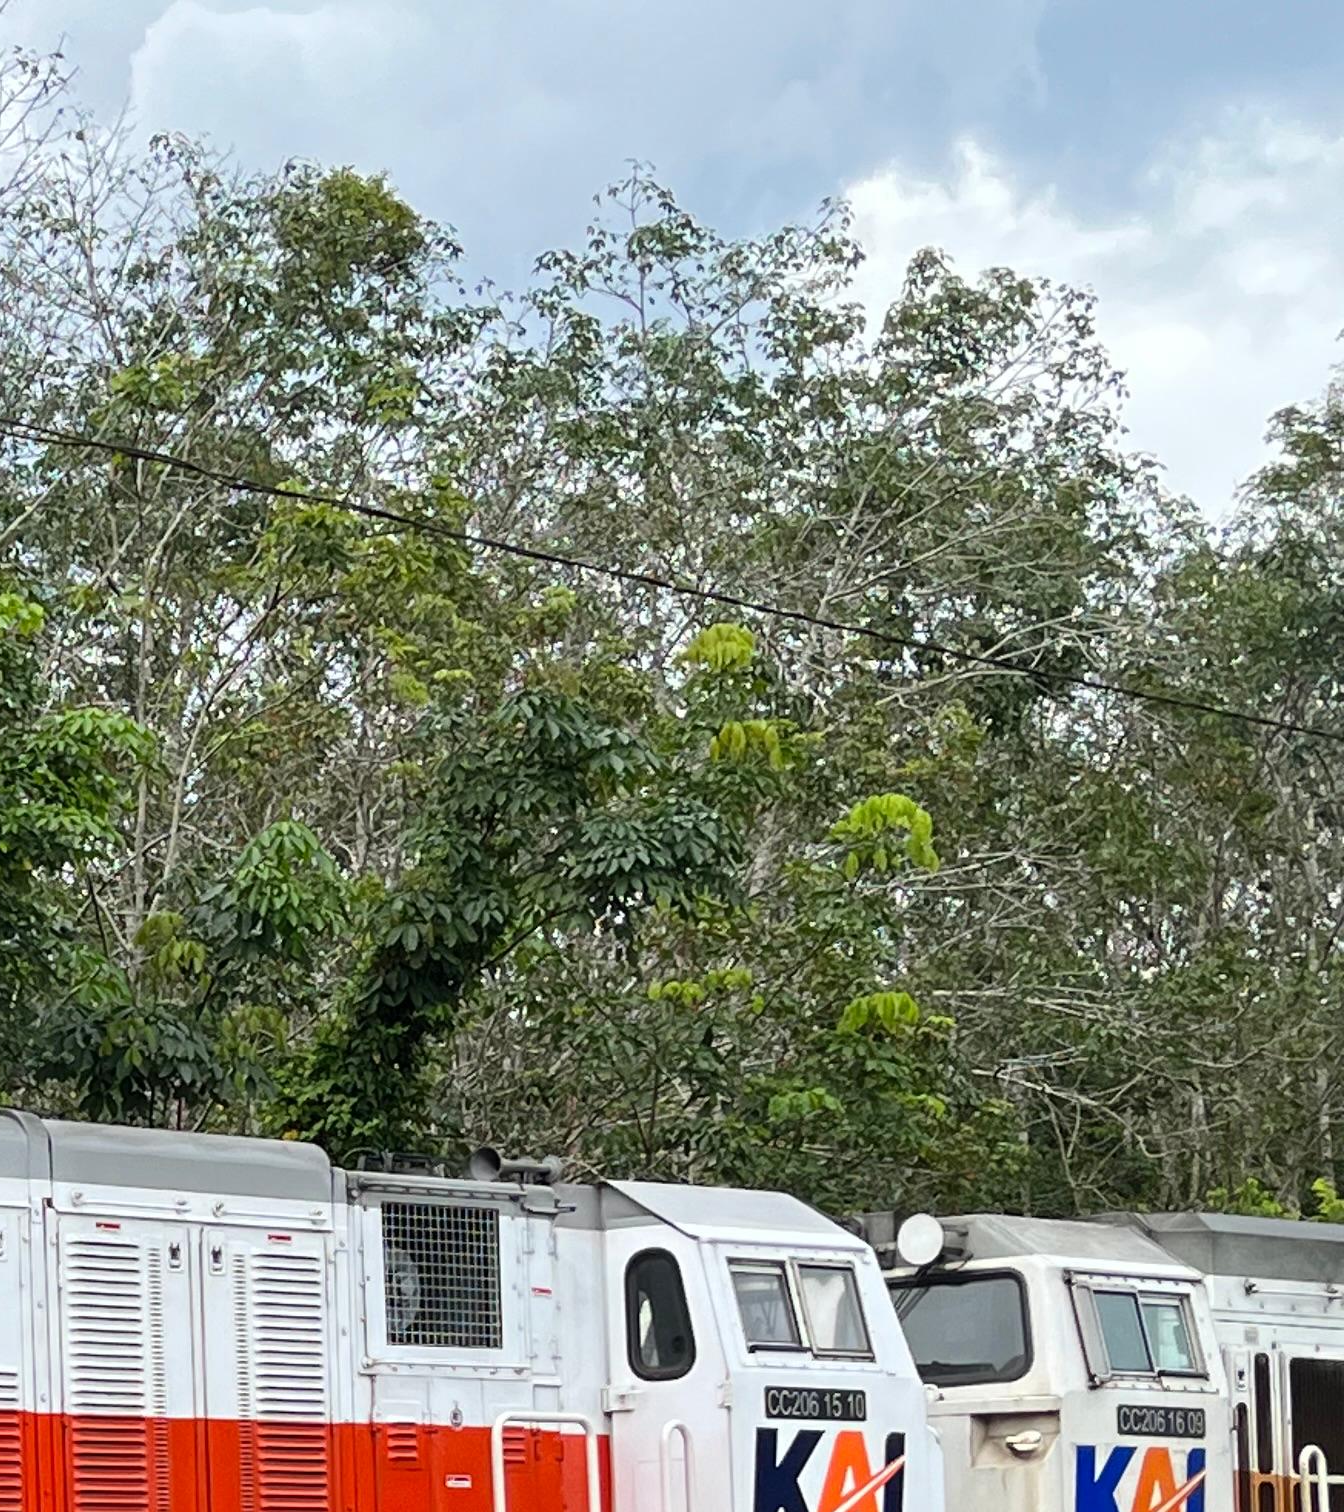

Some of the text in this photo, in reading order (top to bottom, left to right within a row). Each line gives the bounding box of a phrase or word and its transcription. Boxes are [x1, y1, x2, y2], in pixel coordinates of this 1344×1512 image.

[767, 1389, 865, 1418] CC206 15 10
[1119, 1406, 1204, 1435] CC206 16 09
